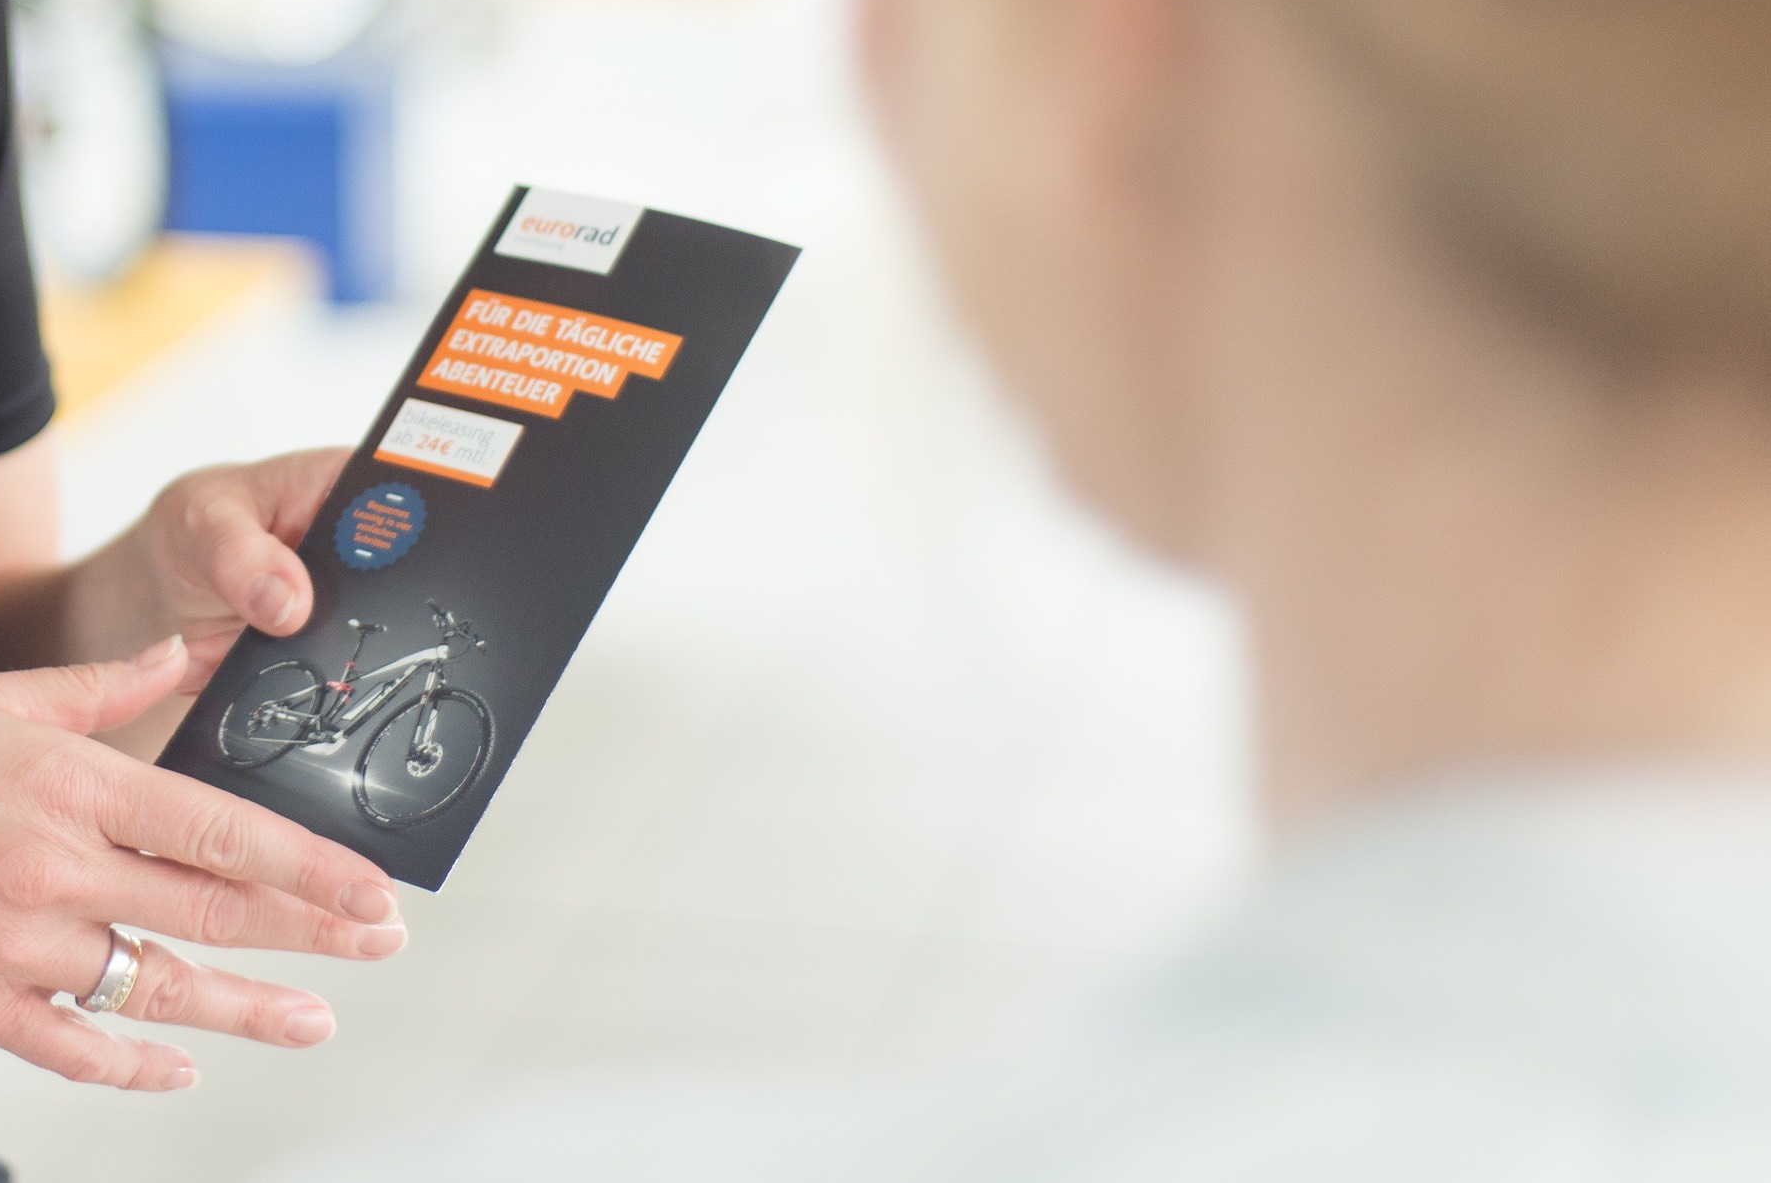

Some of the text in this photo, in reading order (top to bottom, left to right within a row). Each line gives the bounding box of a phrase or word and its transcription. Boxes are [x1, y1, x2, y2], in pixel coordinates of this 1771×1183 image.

[519, 215, 621, 246] eurorad
[463, 297, 667, 365] FÜR DIE TÄGLICHE
[448, 328, 620, 386] EXTRAPORTION
[431, 357, 563, 406] ABENTEUER
[390, 429, 413, 446] ab
[415, 433, 455, 456] 24€
[401, 408, 496, 448] bikeleasing
[353, 508, 385, 526] Leasing
